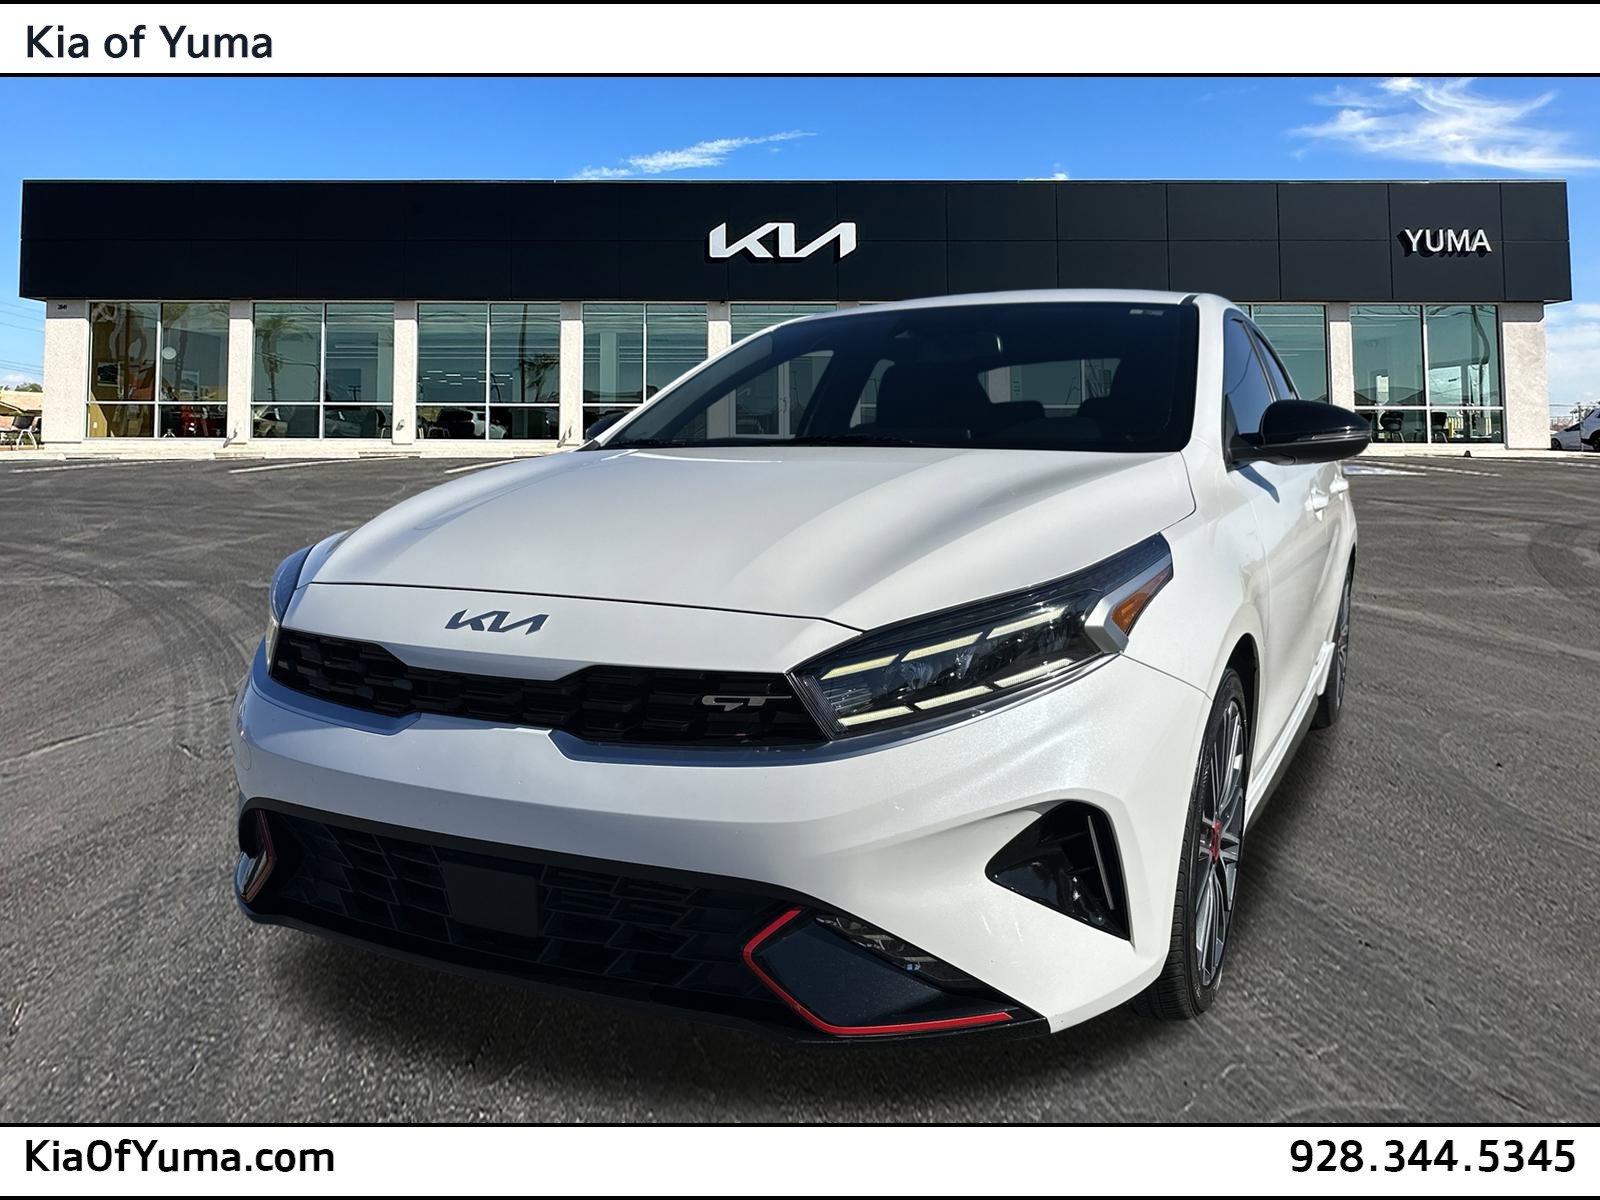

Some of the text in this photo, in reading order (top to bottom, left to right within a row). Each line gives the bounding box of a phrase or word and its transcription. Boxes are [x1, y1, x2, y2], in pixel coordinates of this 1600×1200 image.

[709, 222, 857, 258] KIA
[1404, 228, 1493, 253] YUMA
[445, 608, 549, 636] KIA
[702, 695, 792, 711] GT
